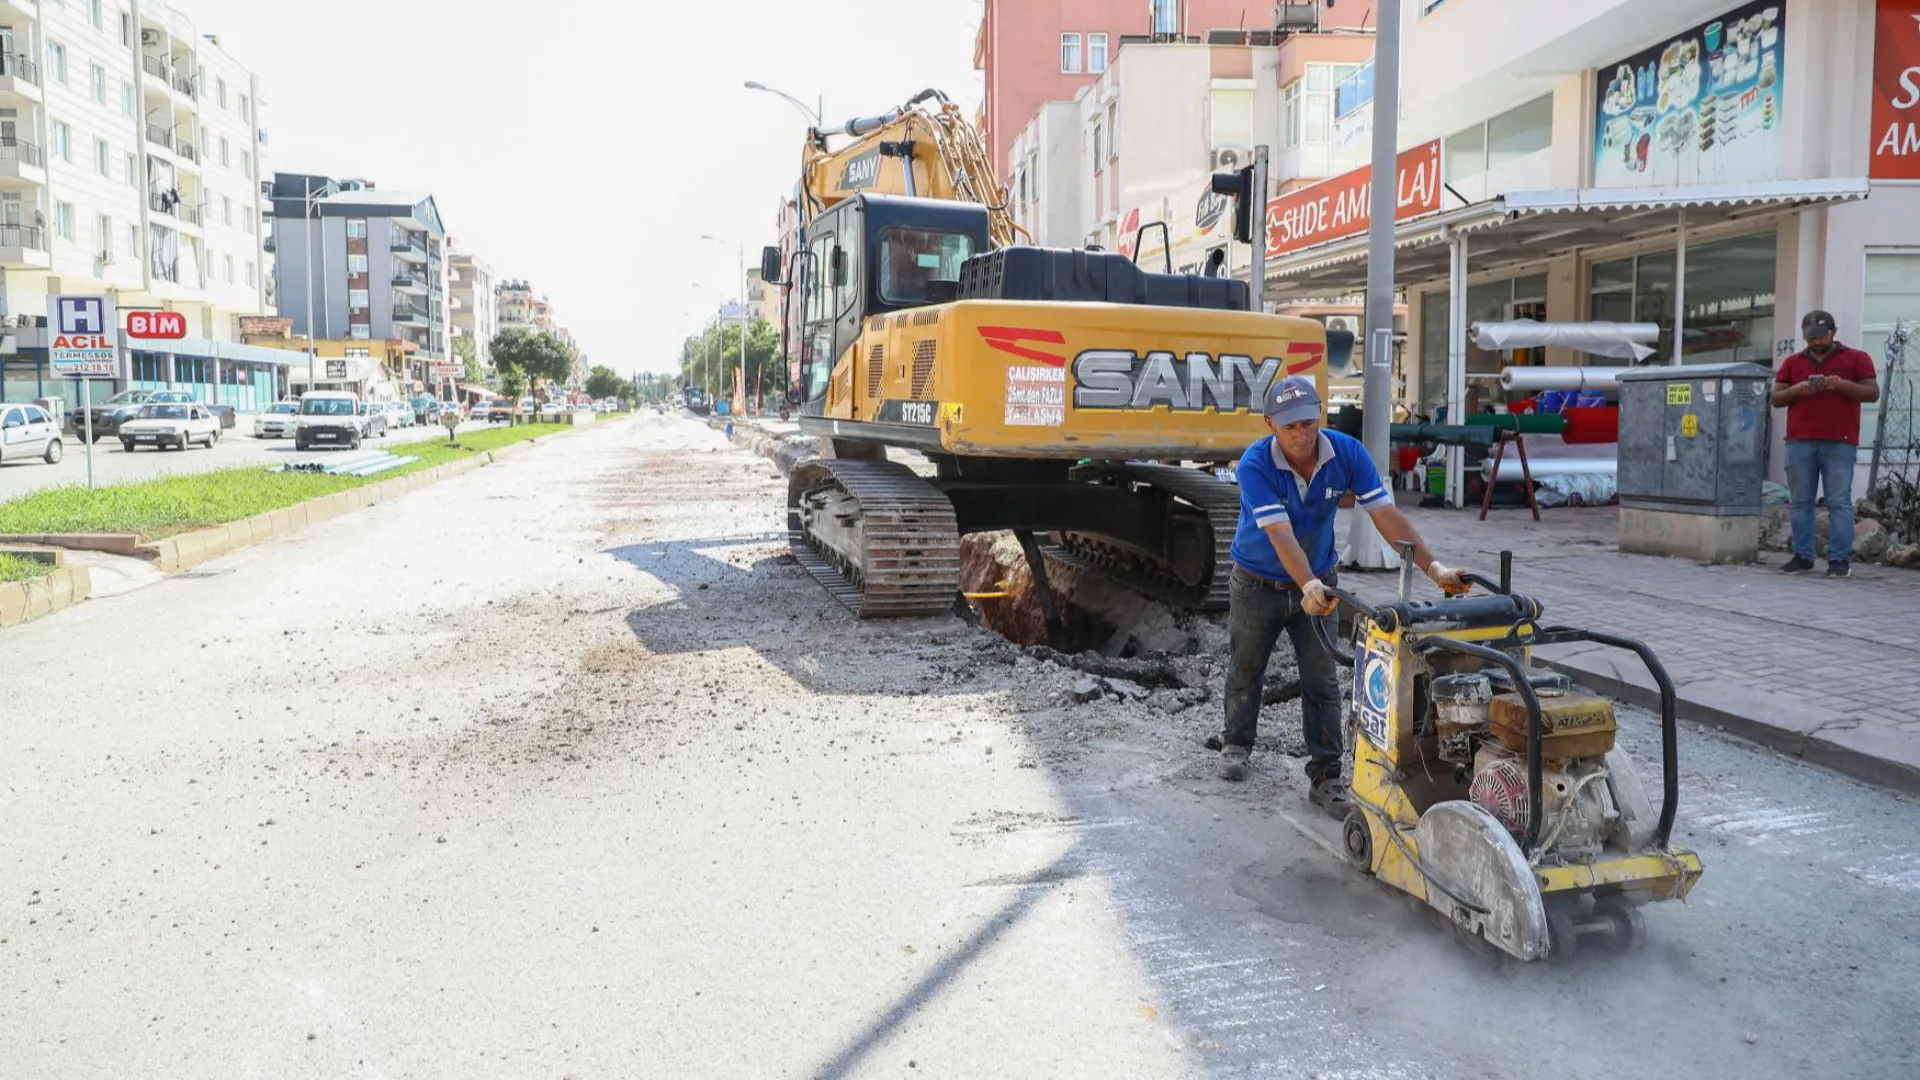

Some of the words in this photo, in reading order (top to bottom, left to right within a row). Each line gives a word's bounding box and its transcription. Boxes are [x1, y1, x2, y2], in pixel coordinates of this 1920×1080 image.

[848, 155, 877, 183] SANY
[1281, 196, 1330, 243] SUDE
[1332, 157, 1438, 228] AMLAJ
[61, 300, 101, 332] H
[132, 313, 180, 333] BİM
[1008, 366, 1065, 384] ÇALIŞIRKEN
[1073, 350, 1280, 409] SANY
[1041, 387, 1063, 405] FAZLA
[902, 402, 931, 424] SY215C
